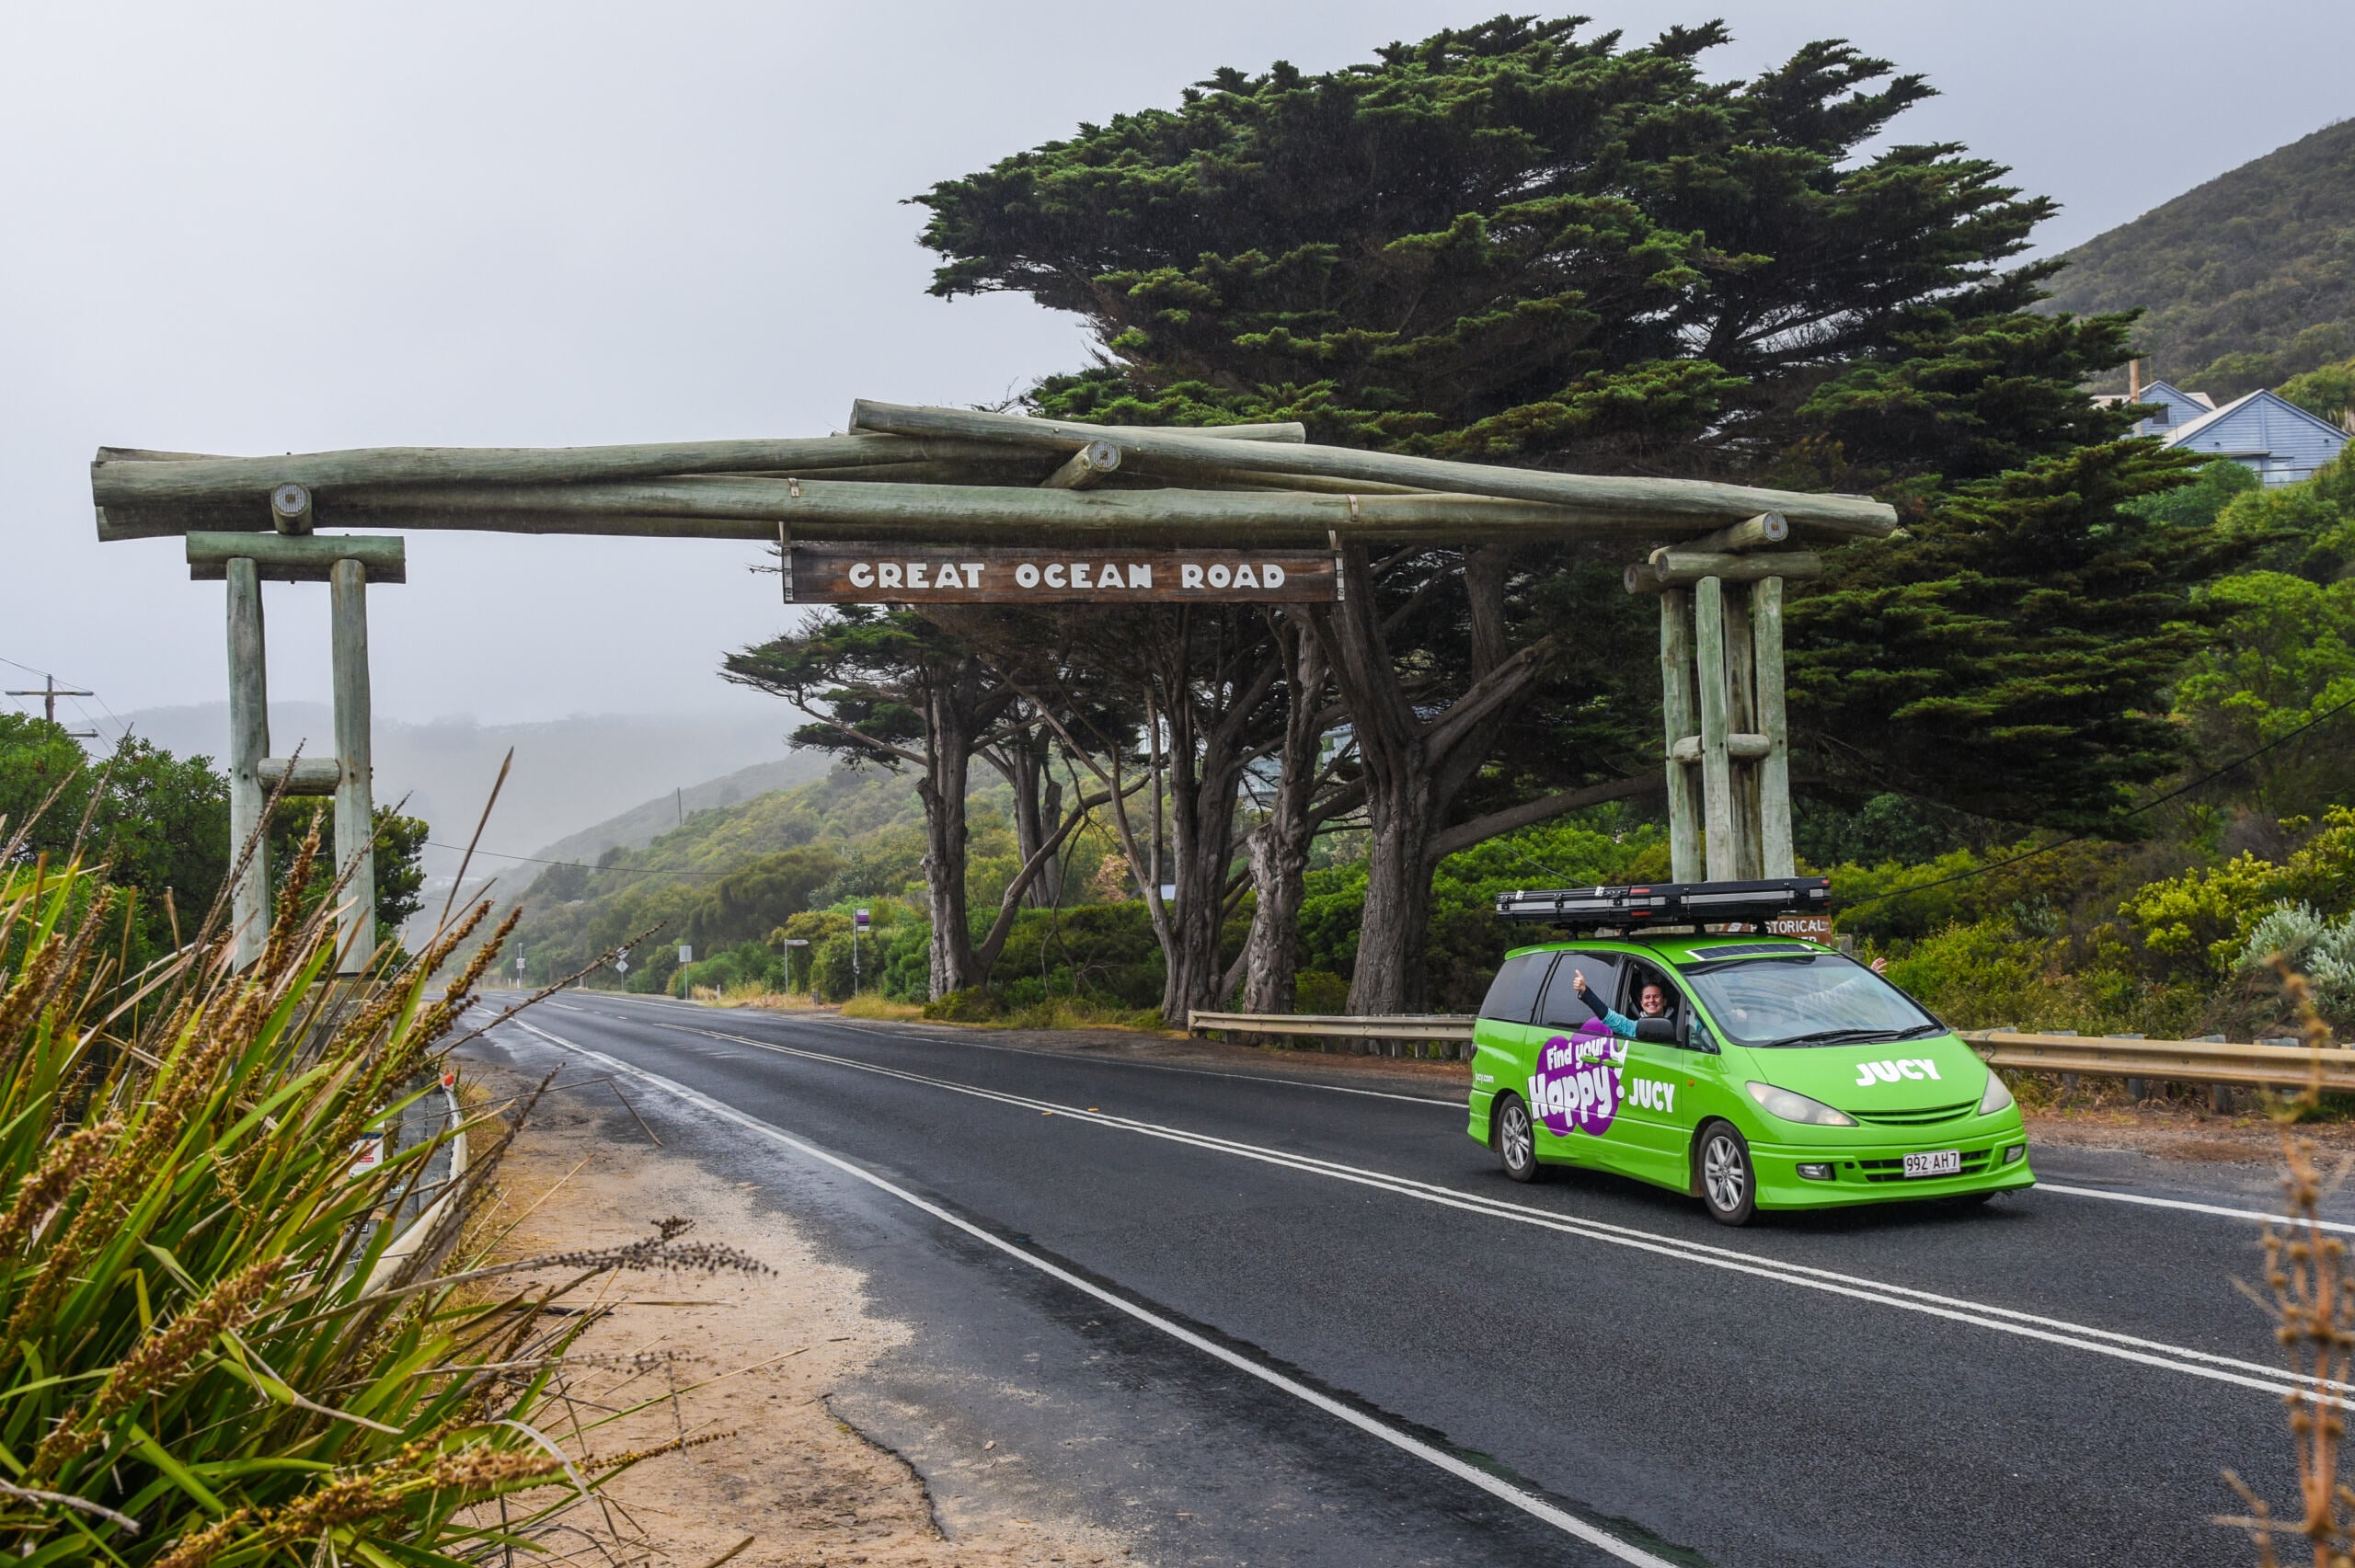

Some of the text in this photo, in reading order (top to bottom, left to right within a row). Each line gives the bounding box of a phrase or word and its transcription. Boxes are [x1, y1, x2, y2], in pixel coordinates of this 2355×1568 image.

[848, 563, 1285, 589] GREAT OCEAN ROAD
[1751, 920, 1825, 933] STORICAL
[1546, 1036, 1607, 1070] Find your
[1855, 1059, 1942, 1086] JUCY
[1628, 1078, 1675, 1113] JUCY
[1907, 1155, 1928, 1172] 992
